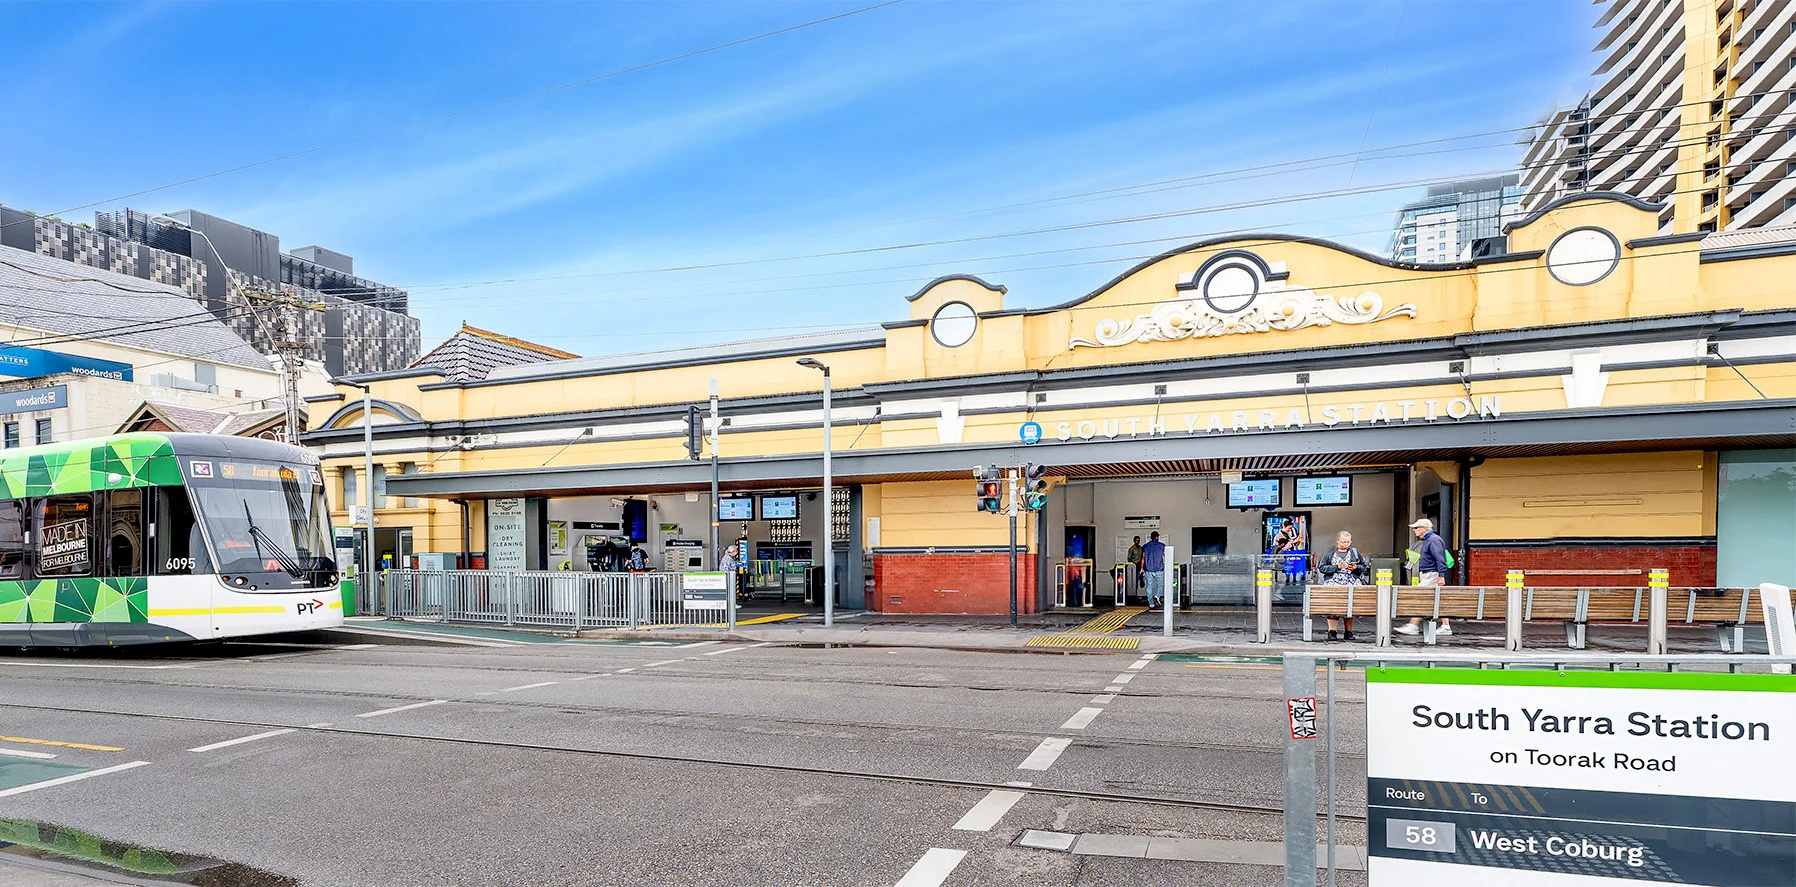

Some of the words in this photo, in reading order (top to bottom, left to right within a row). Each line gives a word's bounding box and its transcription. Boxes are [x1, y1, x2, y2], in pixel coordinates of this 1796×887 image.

[71, 366, 113, 379] woodards
[15, 393, 48, 407] woodards
[1057, 416, 1166, 441] SOUTH
[1184, 408, 1304, 434] YARRA
[1323, 396, 1501, 426] STATION
[41, 524, 73, 546] MADE
[42, 538, 86, 555] MELBOURNE
[43, 558, 55, 568] FOR
[55, 552, 86, 566] MELBOURNE
[165, 557, 196, 570] 6095
[1412, 704, 1510, 731] South
[1520, 708, 1615, 735] Yarra
[1627, 711, 1770, 741] Station
[1490, 751, 1518, 763] on
[1524, 748, 1606, 769] Toorak
[1614, 752, 1676, 772] Road
[1385, 787, 1425, 800] Route
[1471, 792, 1488, 805] To
[1405, 825, 1437, 845] 58
[1470, 830, 1538, 854] West
[1545, 836, 1644, 867] Coburg
